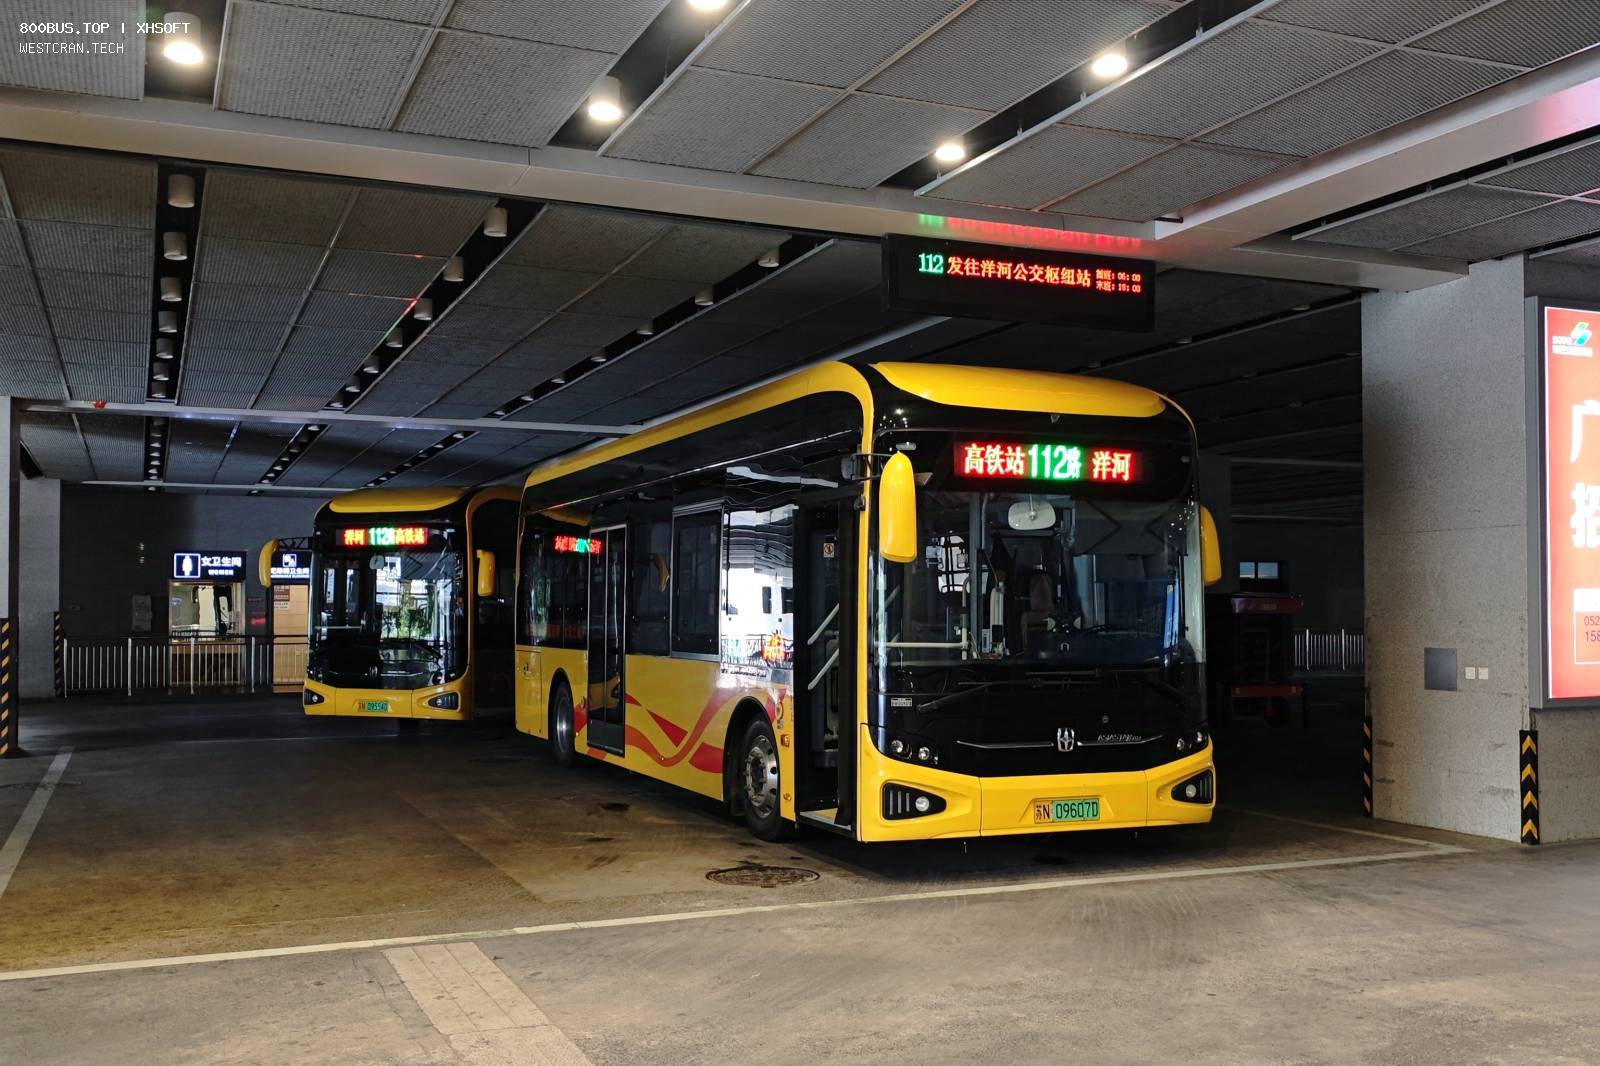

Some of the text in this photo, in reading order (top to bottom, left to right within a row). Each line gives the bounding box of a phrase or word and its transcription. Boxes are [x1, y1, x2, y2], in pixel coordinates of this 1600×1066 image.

[918, 252, 944, 274] 112
[1092, 450, 1132, 481] 洋河
[201, 556, 242, 567] 女卫生间
[1055, 801, 1099, 819] 09607D
